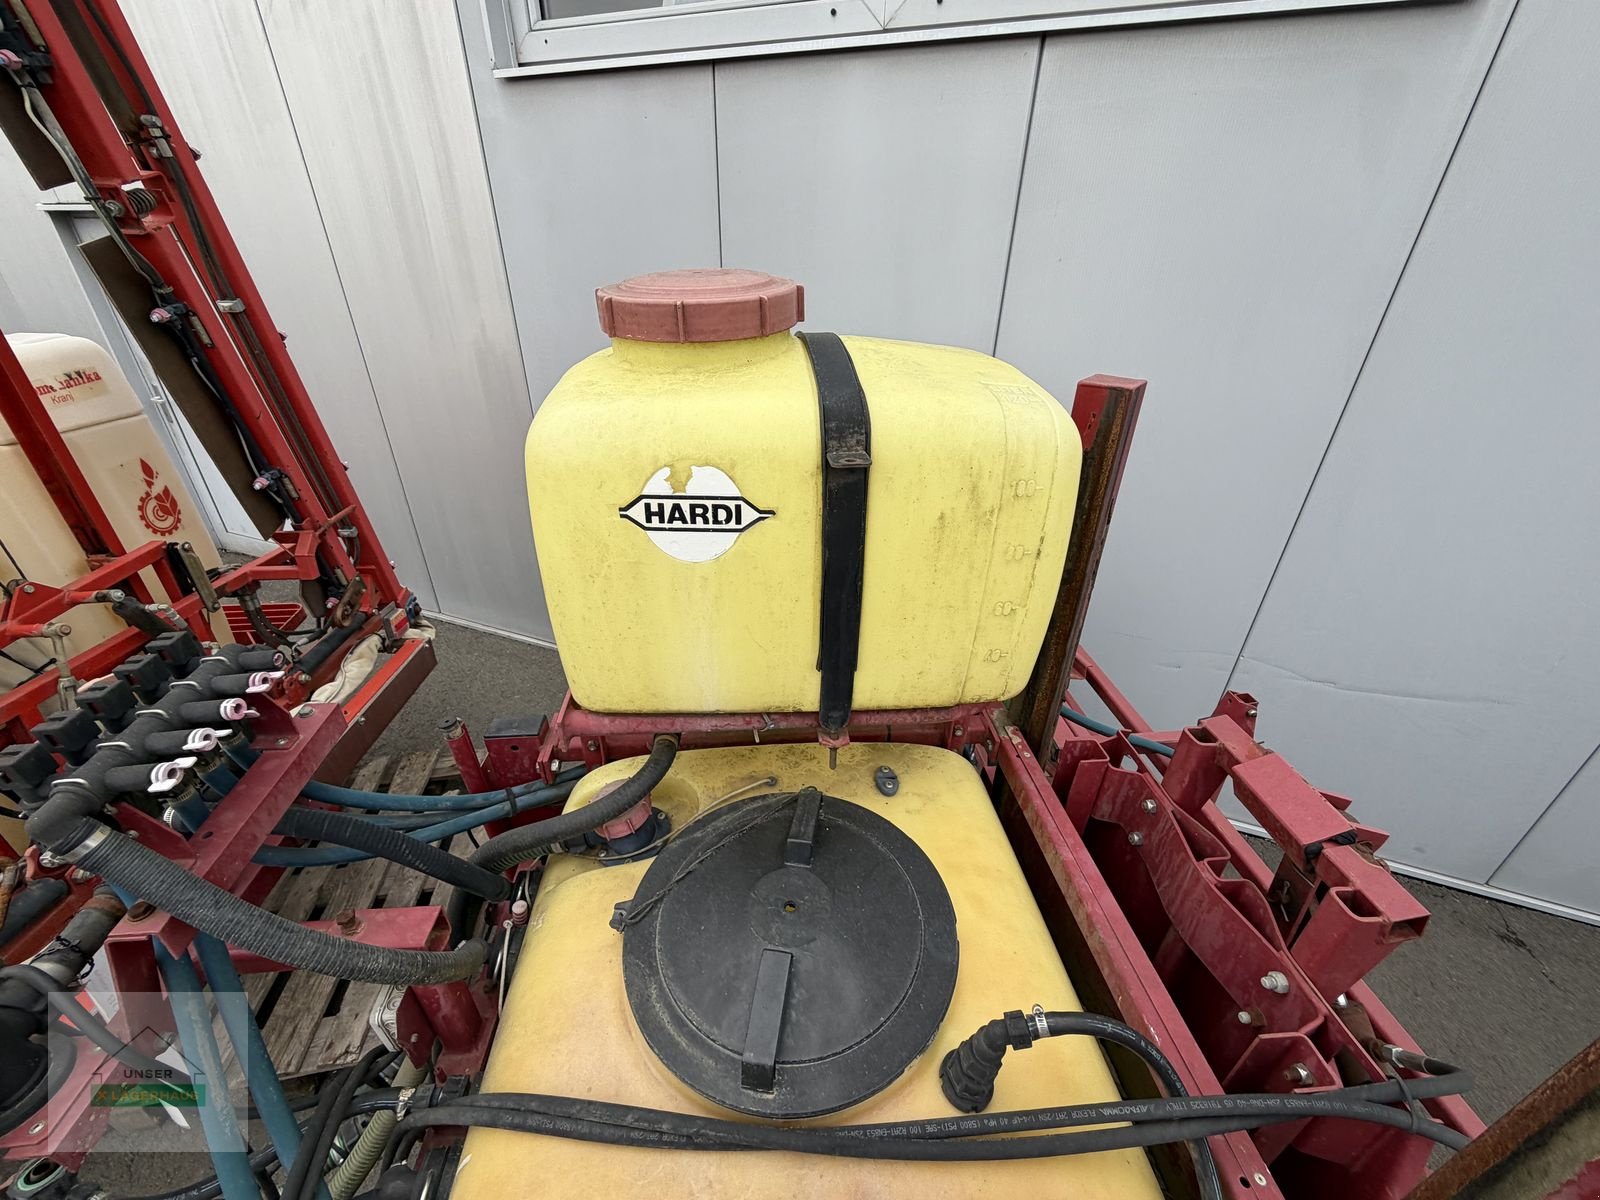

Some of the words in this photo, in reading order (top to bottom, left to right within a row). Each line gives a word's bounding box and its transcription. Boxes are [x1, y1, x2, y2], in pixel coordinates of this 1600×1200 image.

[51, 391, 75, 405] Kranj
[644, 503, 741, 525] HARDI
[995, 601, 1013, 616] 60
